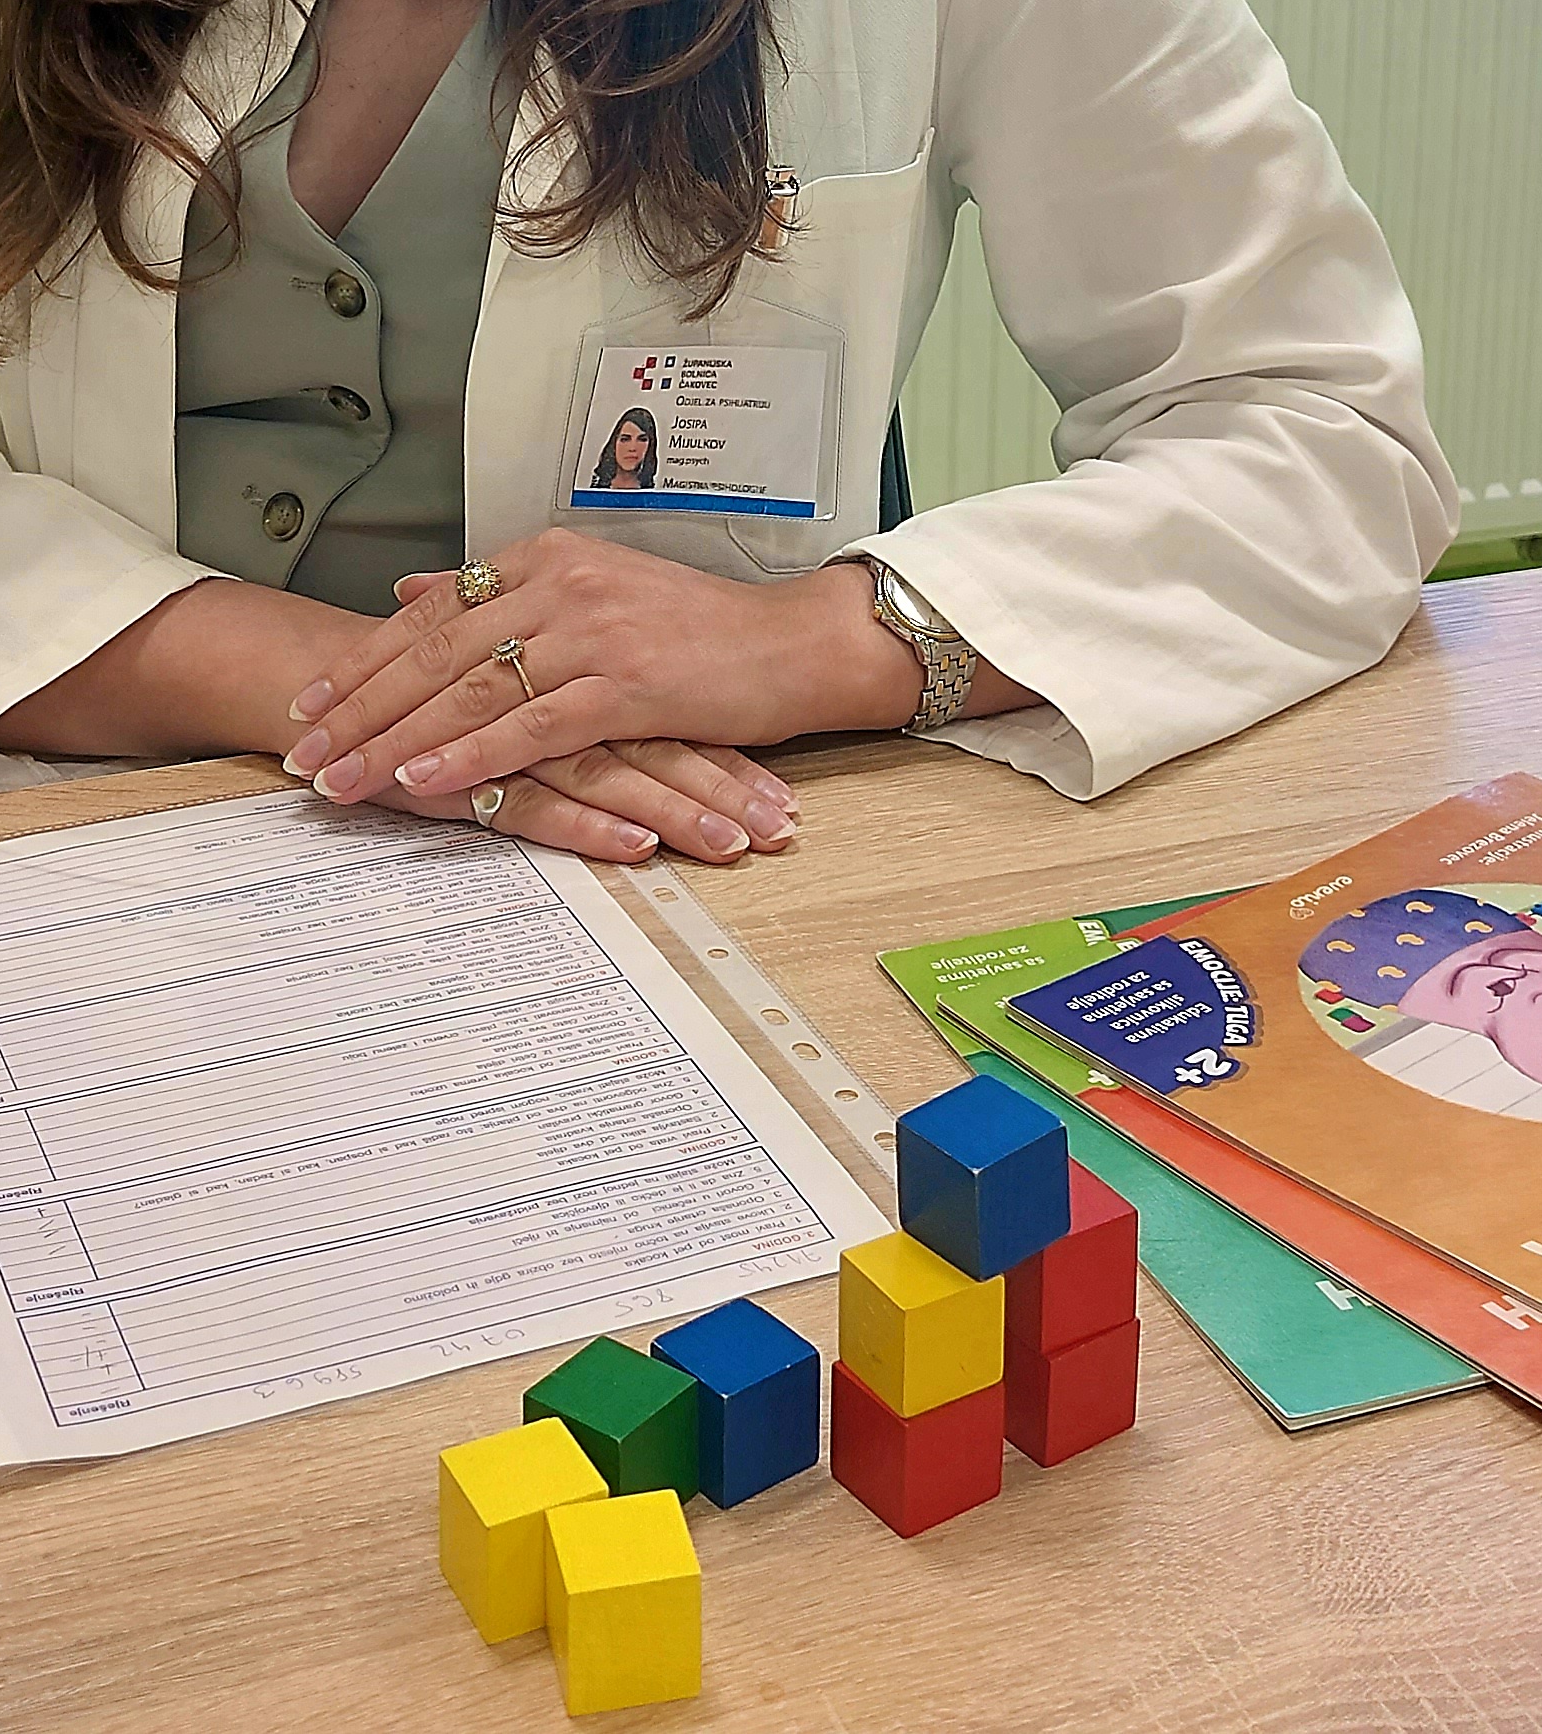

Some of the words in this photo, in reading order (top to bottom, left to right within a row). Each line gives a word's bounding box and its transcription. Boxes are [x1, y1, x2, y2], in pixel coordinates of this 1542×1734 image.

[679, 379, 717, 389] ČAKOVEC
[1438, 832, 1503, 866] Brezovec
[1289, 875, 1353, 908] evenio
[1007, 944, 1029, 956] za
[931, 949, 1006, 971] roditelje
[1024, 955, 1045, 966] sa
[936, 960, 1023, 984] savjetima
[1127, 971, 1150, 983] za
[1151, 980, 1173, 992] sa
[1066, 979, 1131, 1010] roditelje
[1082, 988, 1155, 1023] savjetima
[1109, 993, 1185, 1030] slikovnica
[1124, 1002, 1213, 1043] Edukativna
[1223, 1005, 1250, 1044] TUGA
[1174, 1048, 1233, 1084] 2+
[653, 1081, 674, 1089] Zna
[650, 1093, 683, 1104] Govor
[546, 1105, 567, 1113] dva
[683, 1128, 710, 1138] Pravi
[394, 1140, 416, 1150] kad
[573, 1141, 594, 1149] dva
[649, 1136, 677, 1146] vrata
[679, 1139, 726, 1154] GODINA
[604, 1147, 623, 1156] pet
[557, 1154, 599, 1167] kocaka
[703, 1159, 735, 1170] Može
[296, 1163, 319, 1172] kad
[664, 1167, 698, 1180] stajati
[722, 1172, 744, 1180] Zna
[205, 1183, 228, 1193] kad
[603, 1181, 640, 1194] jednoj
[716, 1184, 754, 1197] Govori
[546, 1198, 568, 1207] bez
[573, 1191, 598, 1201] nozi
[631, 1190, 666, 1202] dečko
[652, 1198, 696, 1212] rečenici
[711, 1195, 764, 1213] Oponaša
[468, 1203, 540, 1226] pridržavanja
[551, 1202, 610, 1220] djevojčica
[666, 1210, 707, 1225] crtanje
[738, 1209, 774, 1222] Likove
[564, 1216, 617, 1233] najmanje
[627, 1221, 662, 1235] kruga
[694, 1218, 731, 1233] stavlja
[756, 1221, 784, 1233] Pravi
[511, 1233, 541, 1246] riječi
[634, 1236, 668, 1248] točno
[721, 1230, 750, 1242] most
[672, 1244, 693, 1255] pet
[752, 1235, 801, 1251] GODINA
[587, 1245, 628, 1260] mjesto
[560, 1257, 583, 1266] bez
[625, 1252, 668, 1268] kocaka
[517, 1264, 554, 1277] obzira
[484, 1273, 511, 1285] gdje
[24, 1286, 86, 1306] Rješenje
[402, 1285, 460, 1305] položimo
[67, 1396, 132, 1421] Rješenje
